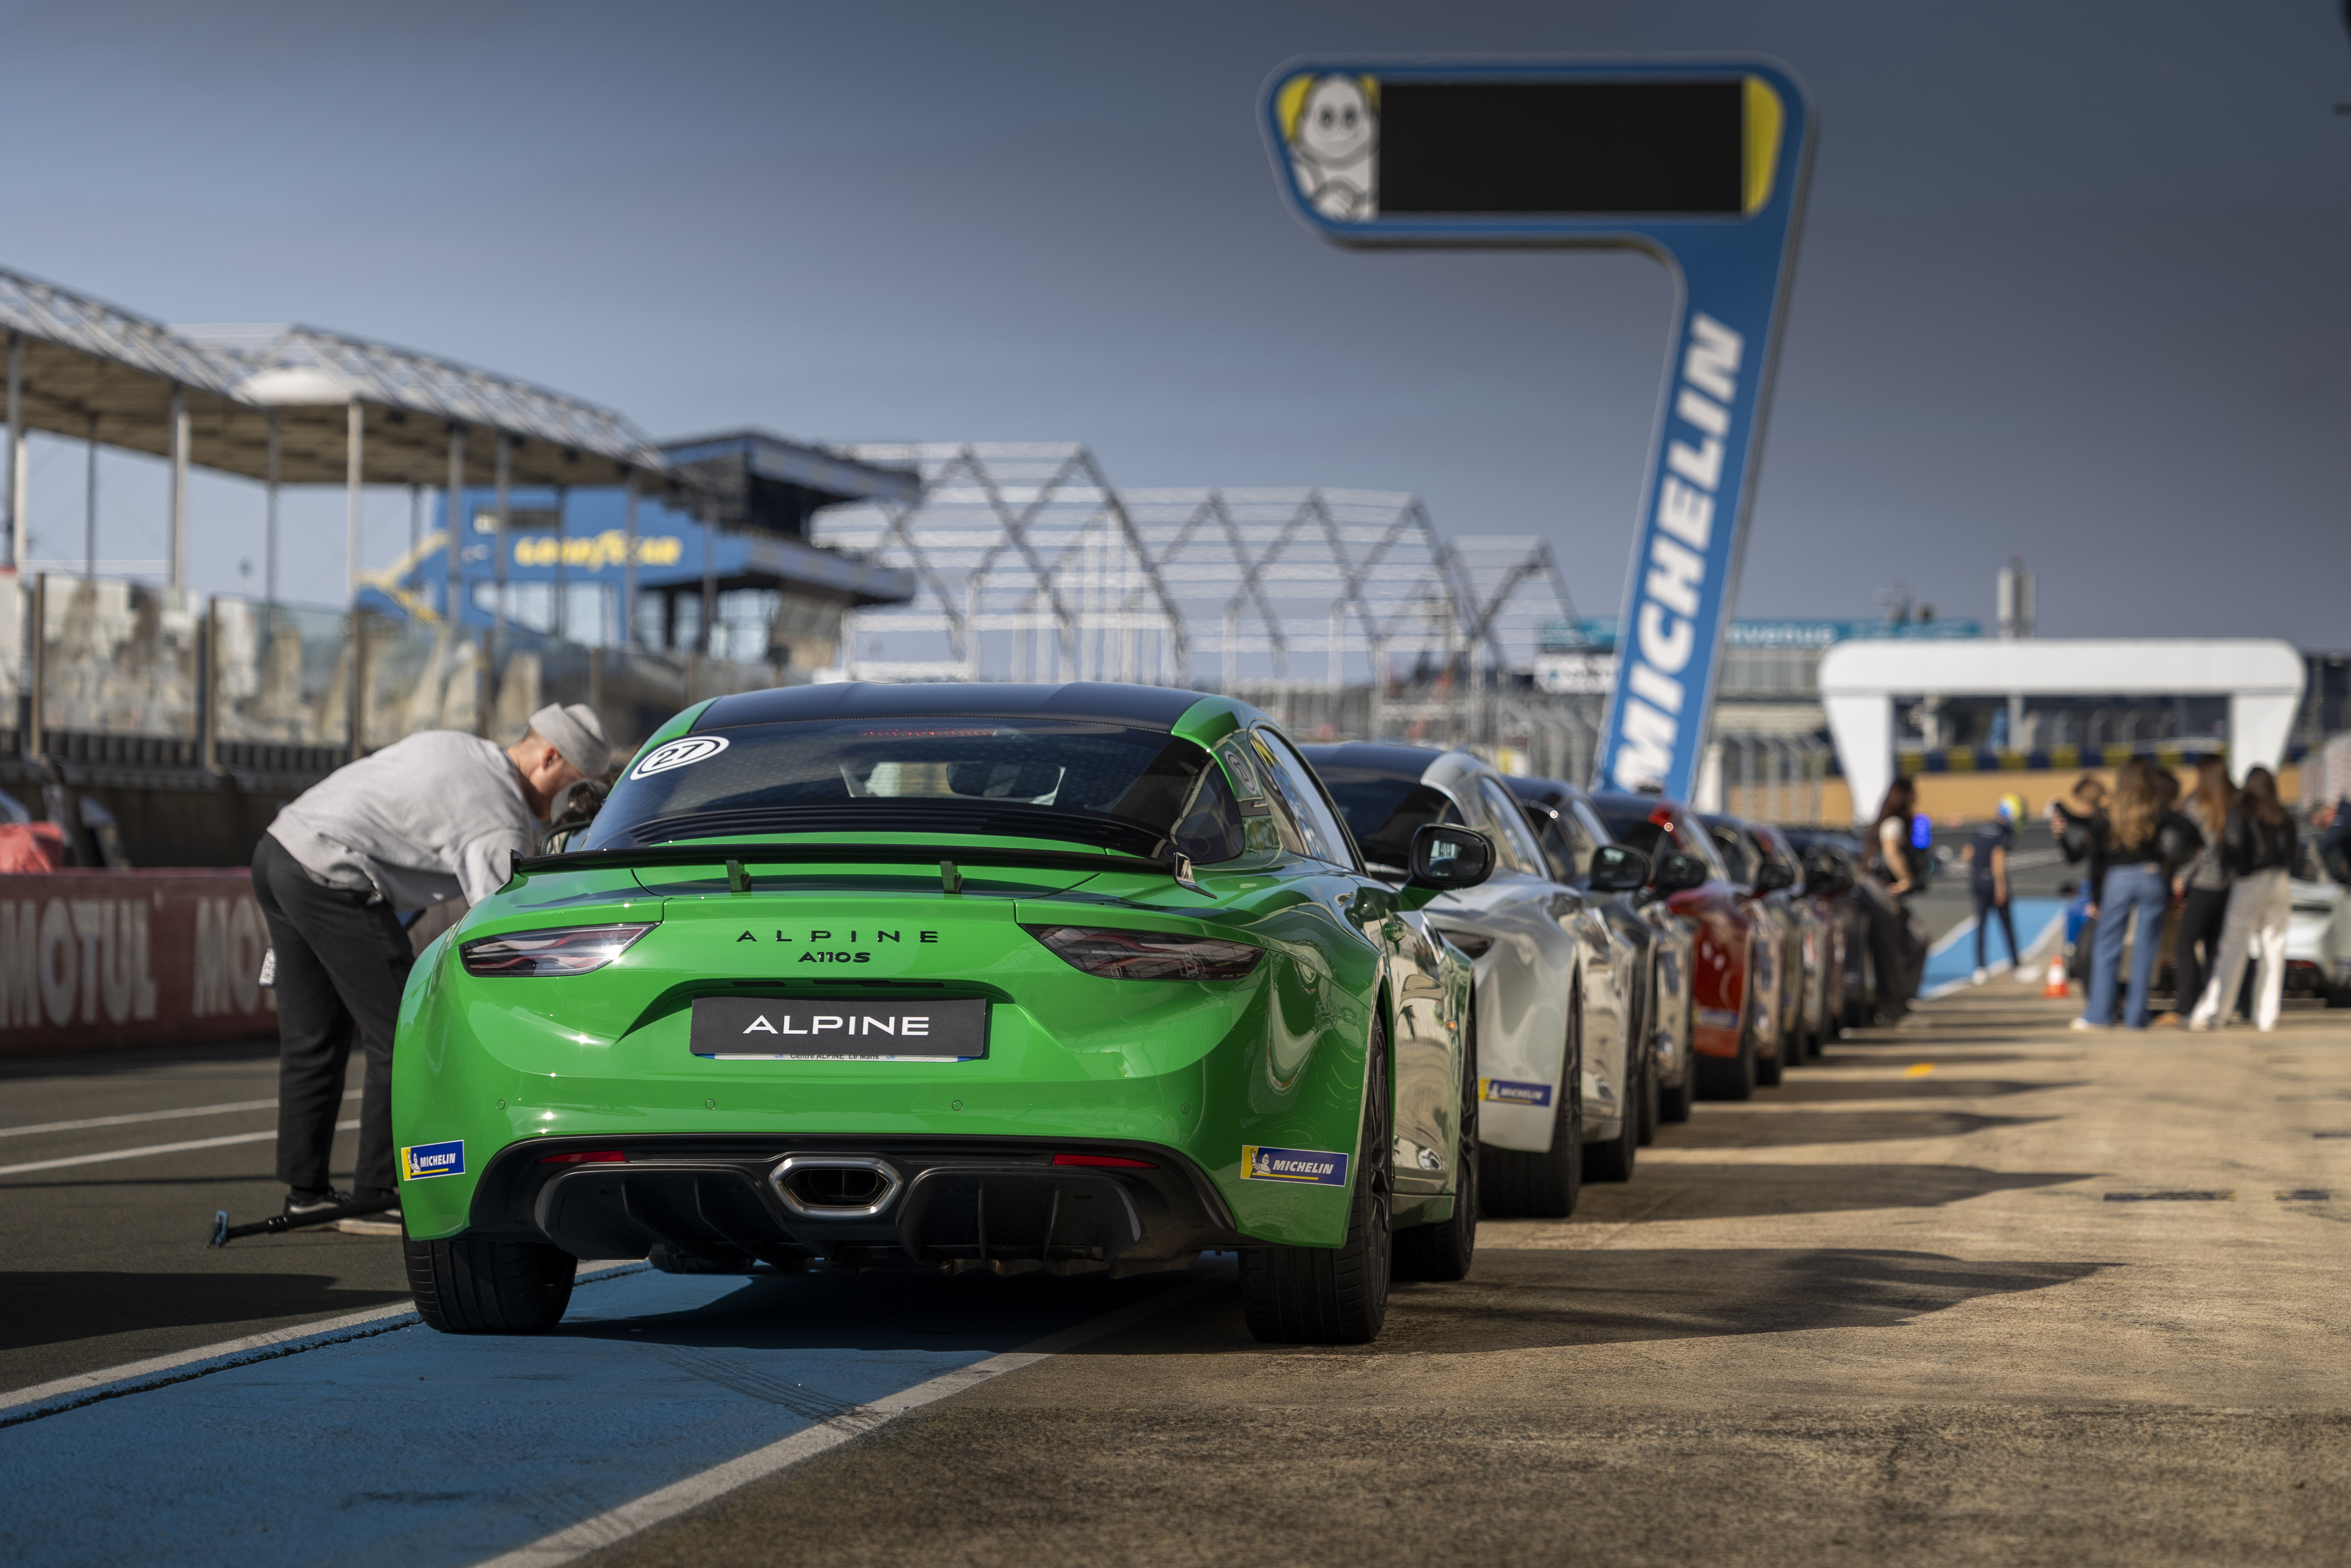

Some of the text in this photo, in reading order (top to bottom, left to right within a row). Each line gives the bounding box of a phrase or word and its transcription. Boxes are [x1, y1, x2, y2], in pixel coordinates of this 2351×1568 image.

[1613, 309, 1745, 794] MICHELIN
[651, 743, 704, 768] 27
[736, 930, 938, 943] ALPINE
[0, 897, 158, 1028] MOTUL
[798, 951, 871, 963] A110S
[743, 1015, 929, 1035] ALPINE
[420, 1153, 456, 1167] MICHELIN
[1272, 1160, 1333, 1174] MICHELIN
